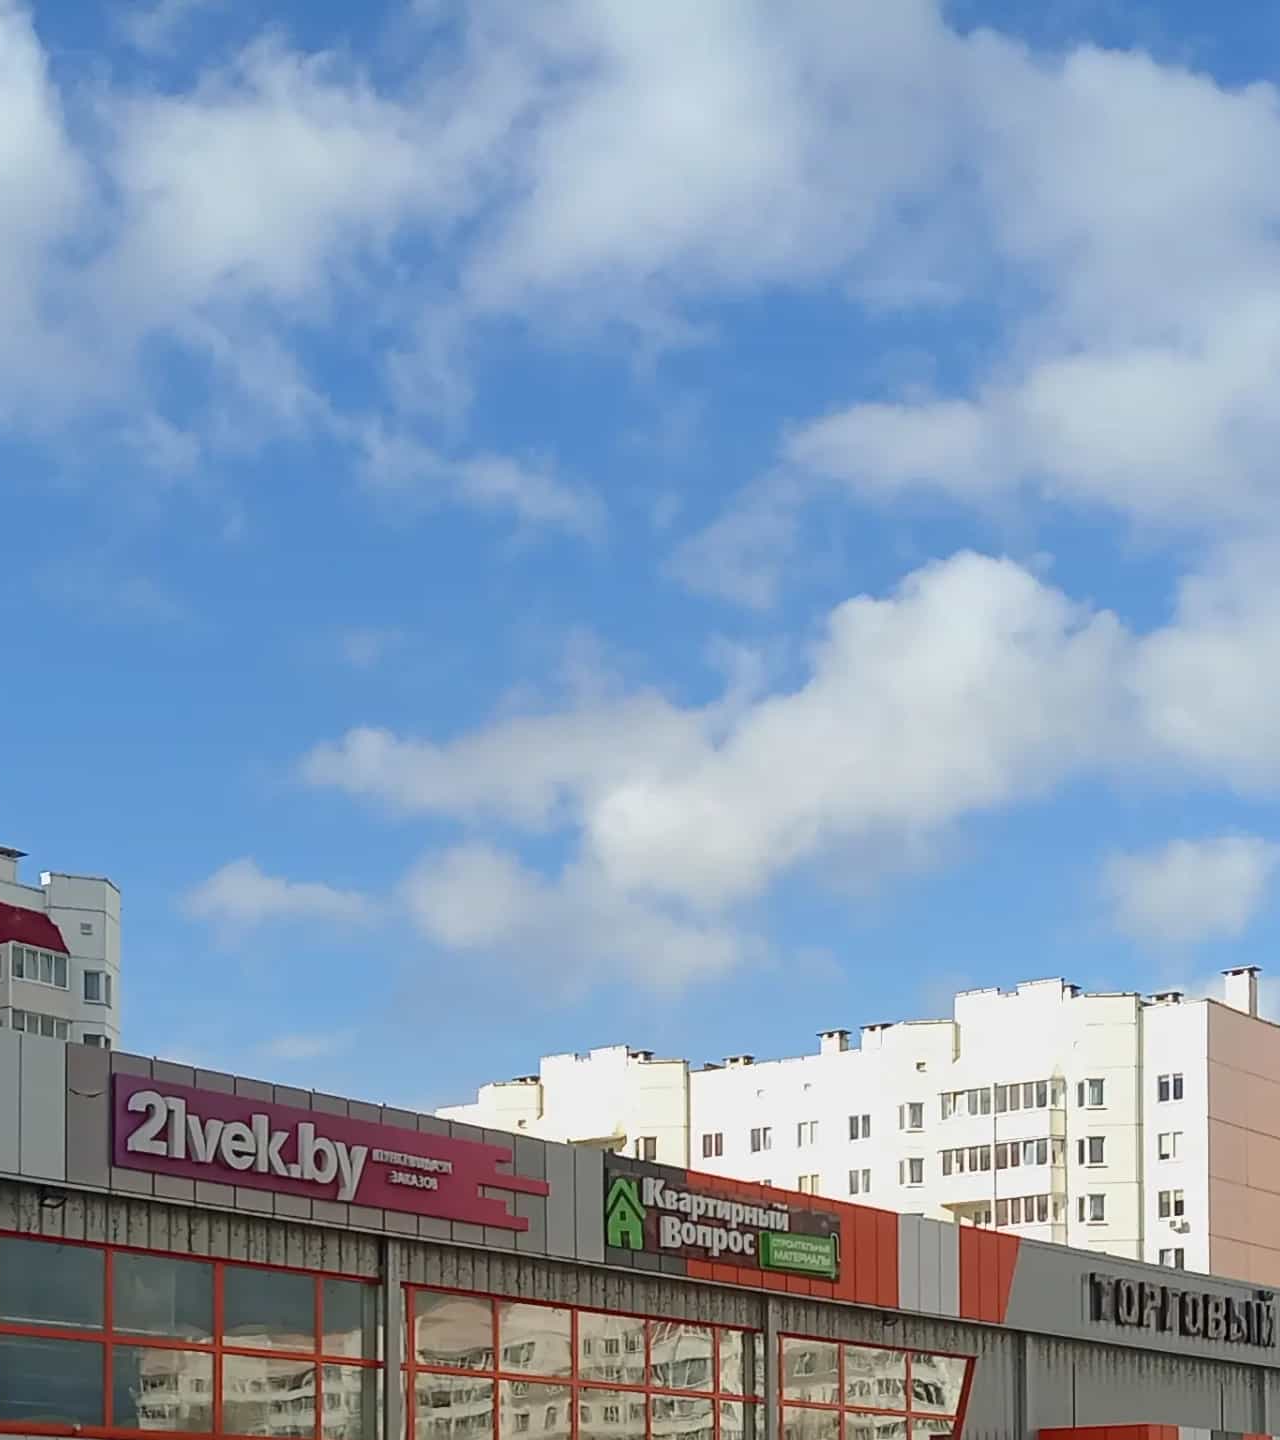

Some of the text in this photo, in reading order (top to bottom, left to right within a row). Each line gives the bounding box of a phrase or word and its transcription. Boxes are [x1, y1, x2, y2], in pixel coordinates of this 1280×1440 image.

[127, 1091, 368, 1200] 21vek.by
[643, 1177, 789, 1231] Квартирный
[660, 1215, 755, 1256] Вопрос
[1089, 1272, 1276, 1348] ТОРГОВЫЙ
